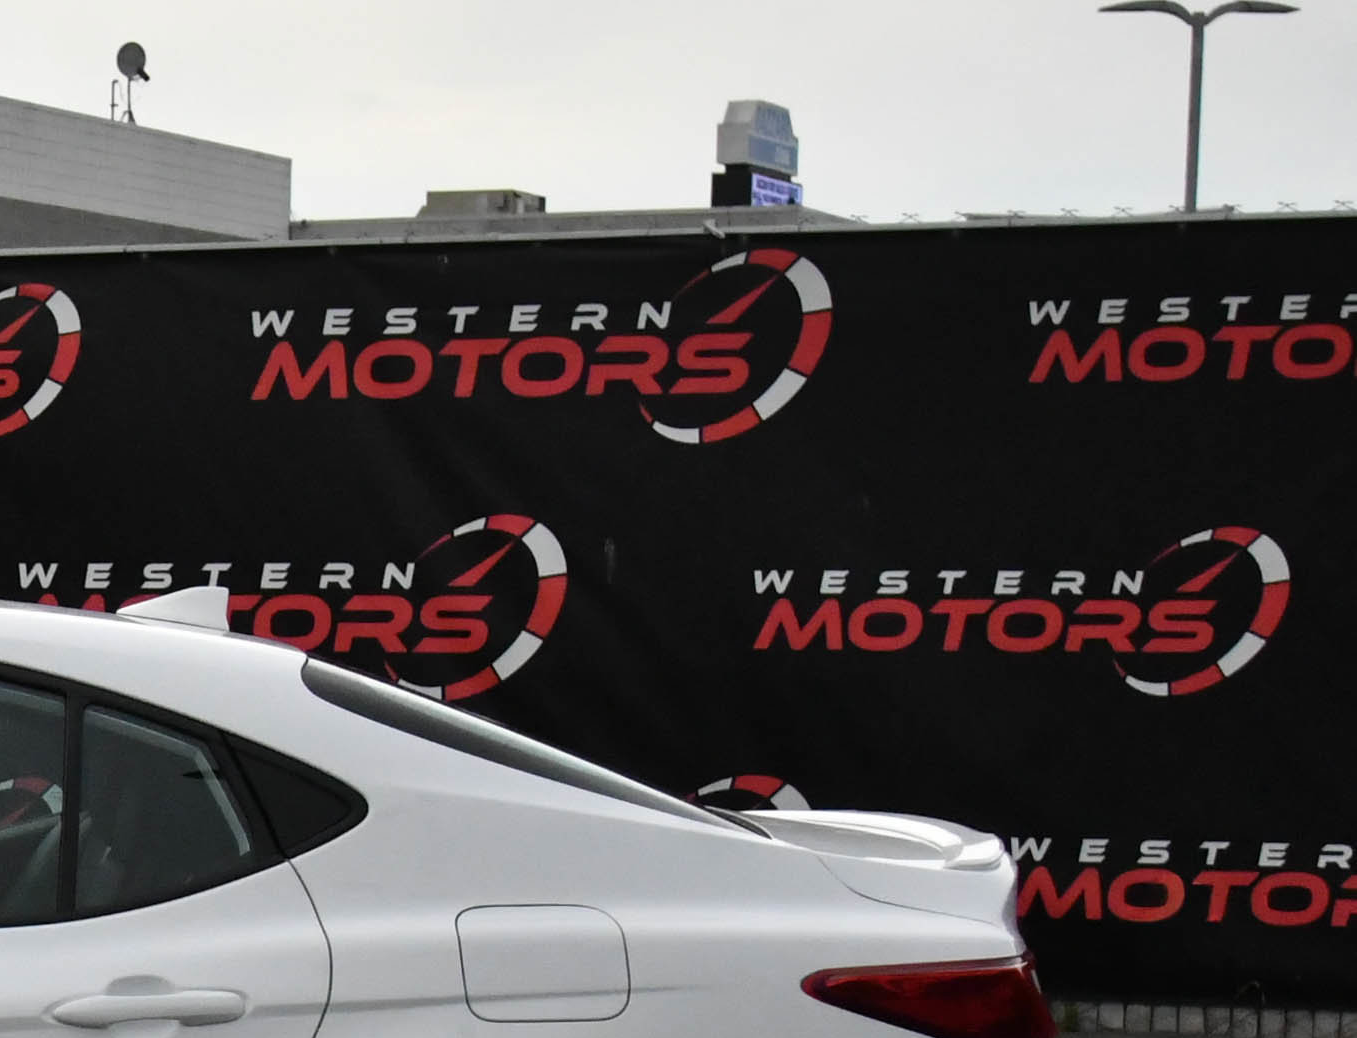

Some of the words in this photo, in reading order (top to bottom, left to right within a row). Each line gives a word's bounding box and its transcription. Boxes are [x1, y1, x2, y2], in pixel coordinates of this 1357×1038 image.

[252, 302, 672, 338] WESTERN
[1029, 294, 1357, 325] WESTE
[252, 332, 752, 400] MOTORS
[1029, 323, 1357, 383] MOTO
[19, 562, 415, 590] WESTERN
[754, 569, 1145, 595] WESTERN
[753, 597, 1217, 653] MOTORS
[1011, 837, 1354, 869] WESTER
[1016, 865, 1357, 928] MOTO
